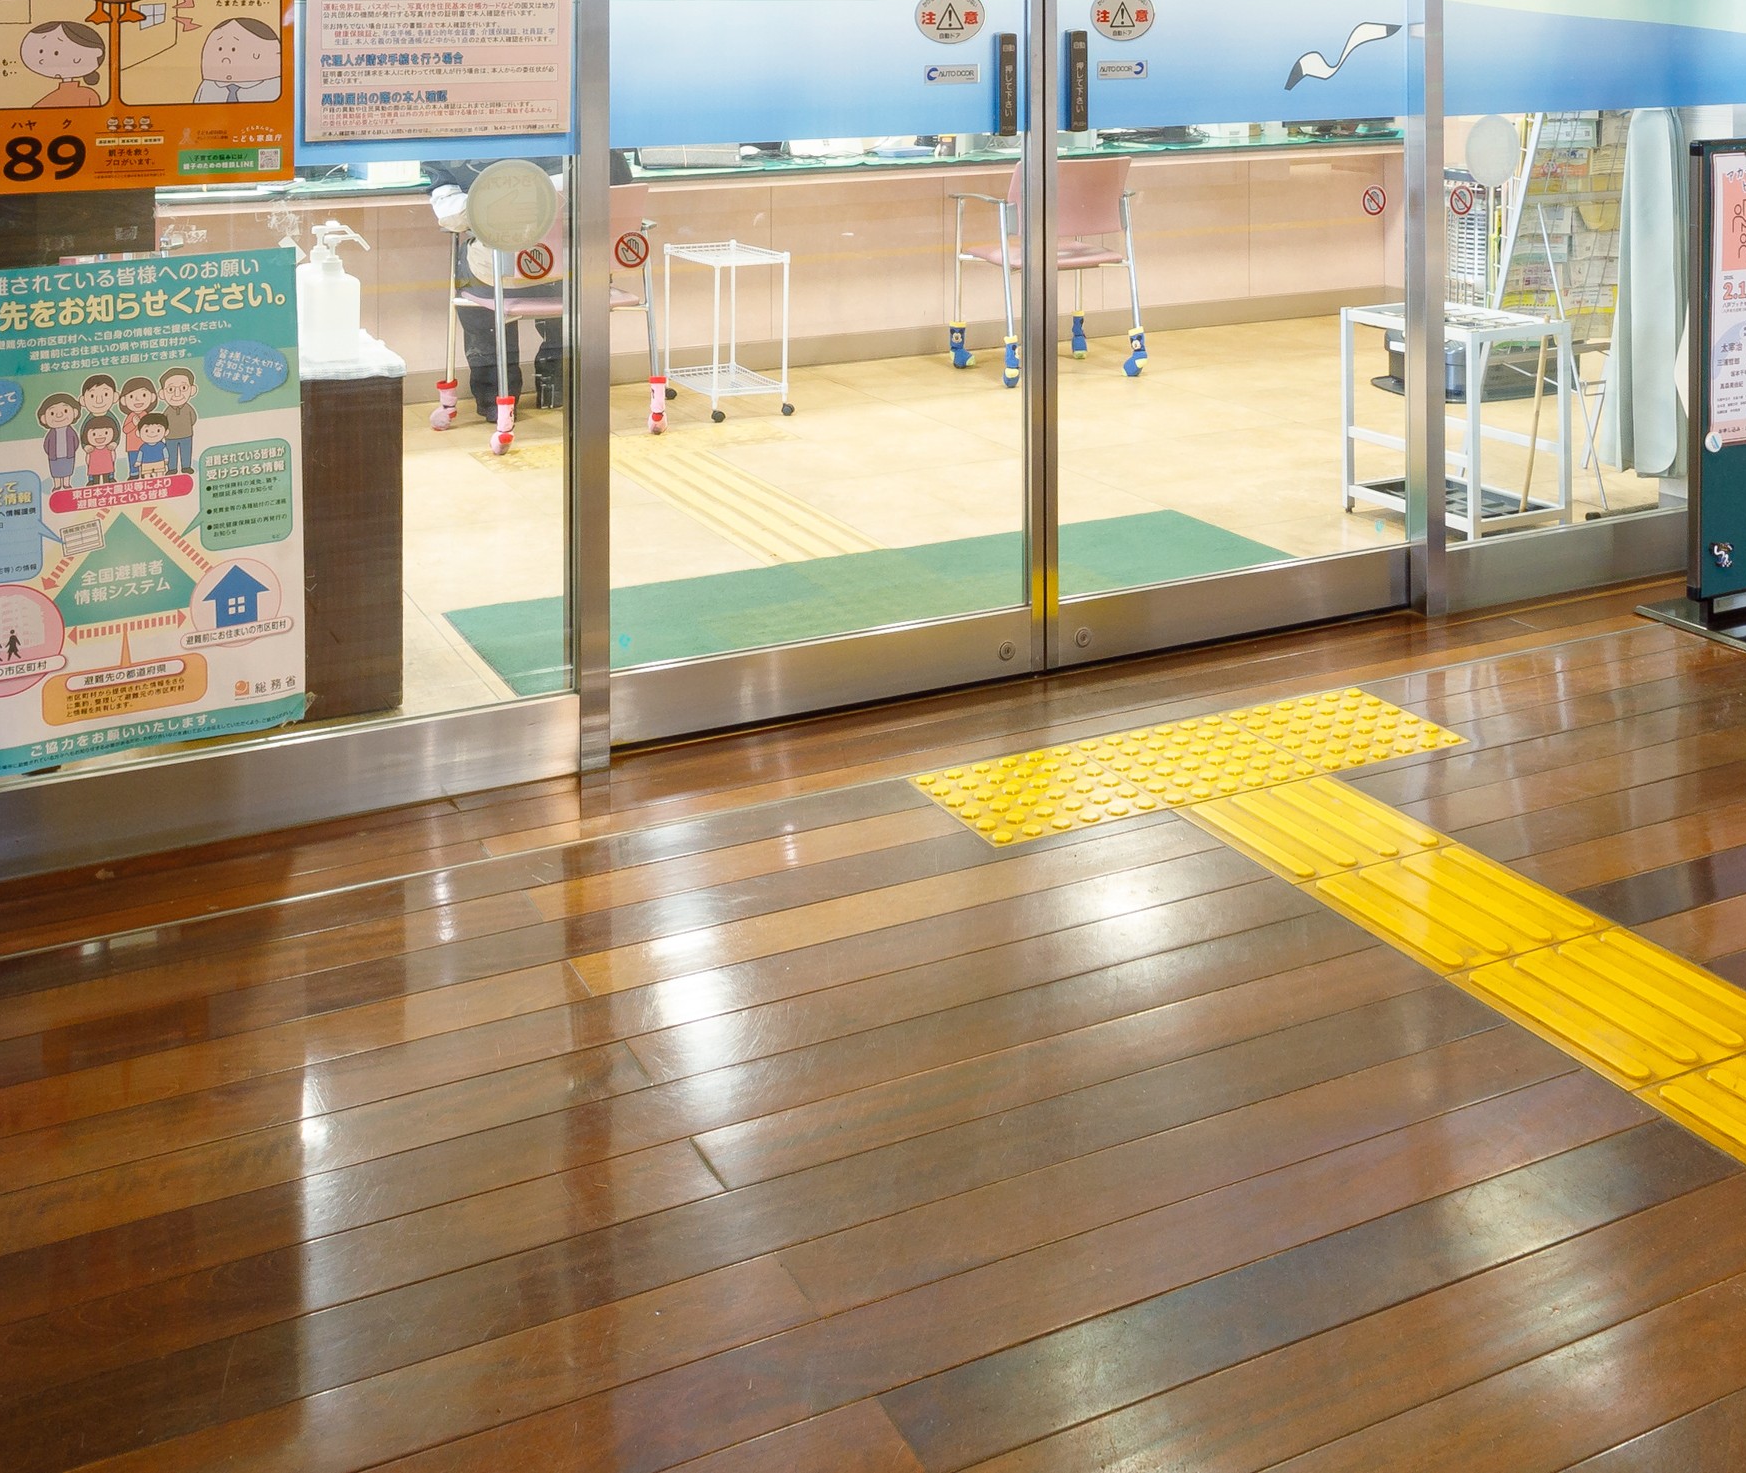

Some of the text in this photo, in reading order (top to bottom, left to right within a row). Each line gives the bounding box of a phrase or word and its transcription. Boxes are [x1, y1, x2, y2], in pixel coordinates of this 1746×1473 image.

[320, 52, 464, 68] 代理人が請求手続を行う場合
[321, 90, 448, 106] 異動届出の際の本人確認
[62, 118, 73, 130] ク
[39, 350, 193, 374] 様々なお知らせをお届けできます。
[204, 446, 285, 468] 避難されている皆様が
[205, 460, 286, 481] 受けられる情報
[72, 477, 173, 500] 東日本大震災等により
[76, 488, 169, 510] 避難されている皆様
[81, 559, 165, 587] 全国避難者
[74, 577, 171, 606] 情報システム
[185, 620, 287, 647] 避難前にお住まいの市区町村
[83, 663, 167, 687] 避難先の都道府県
[254, 675, 297, 696] 総務省
[30, 715, 218, 758] ご協力をお願いいたします。
